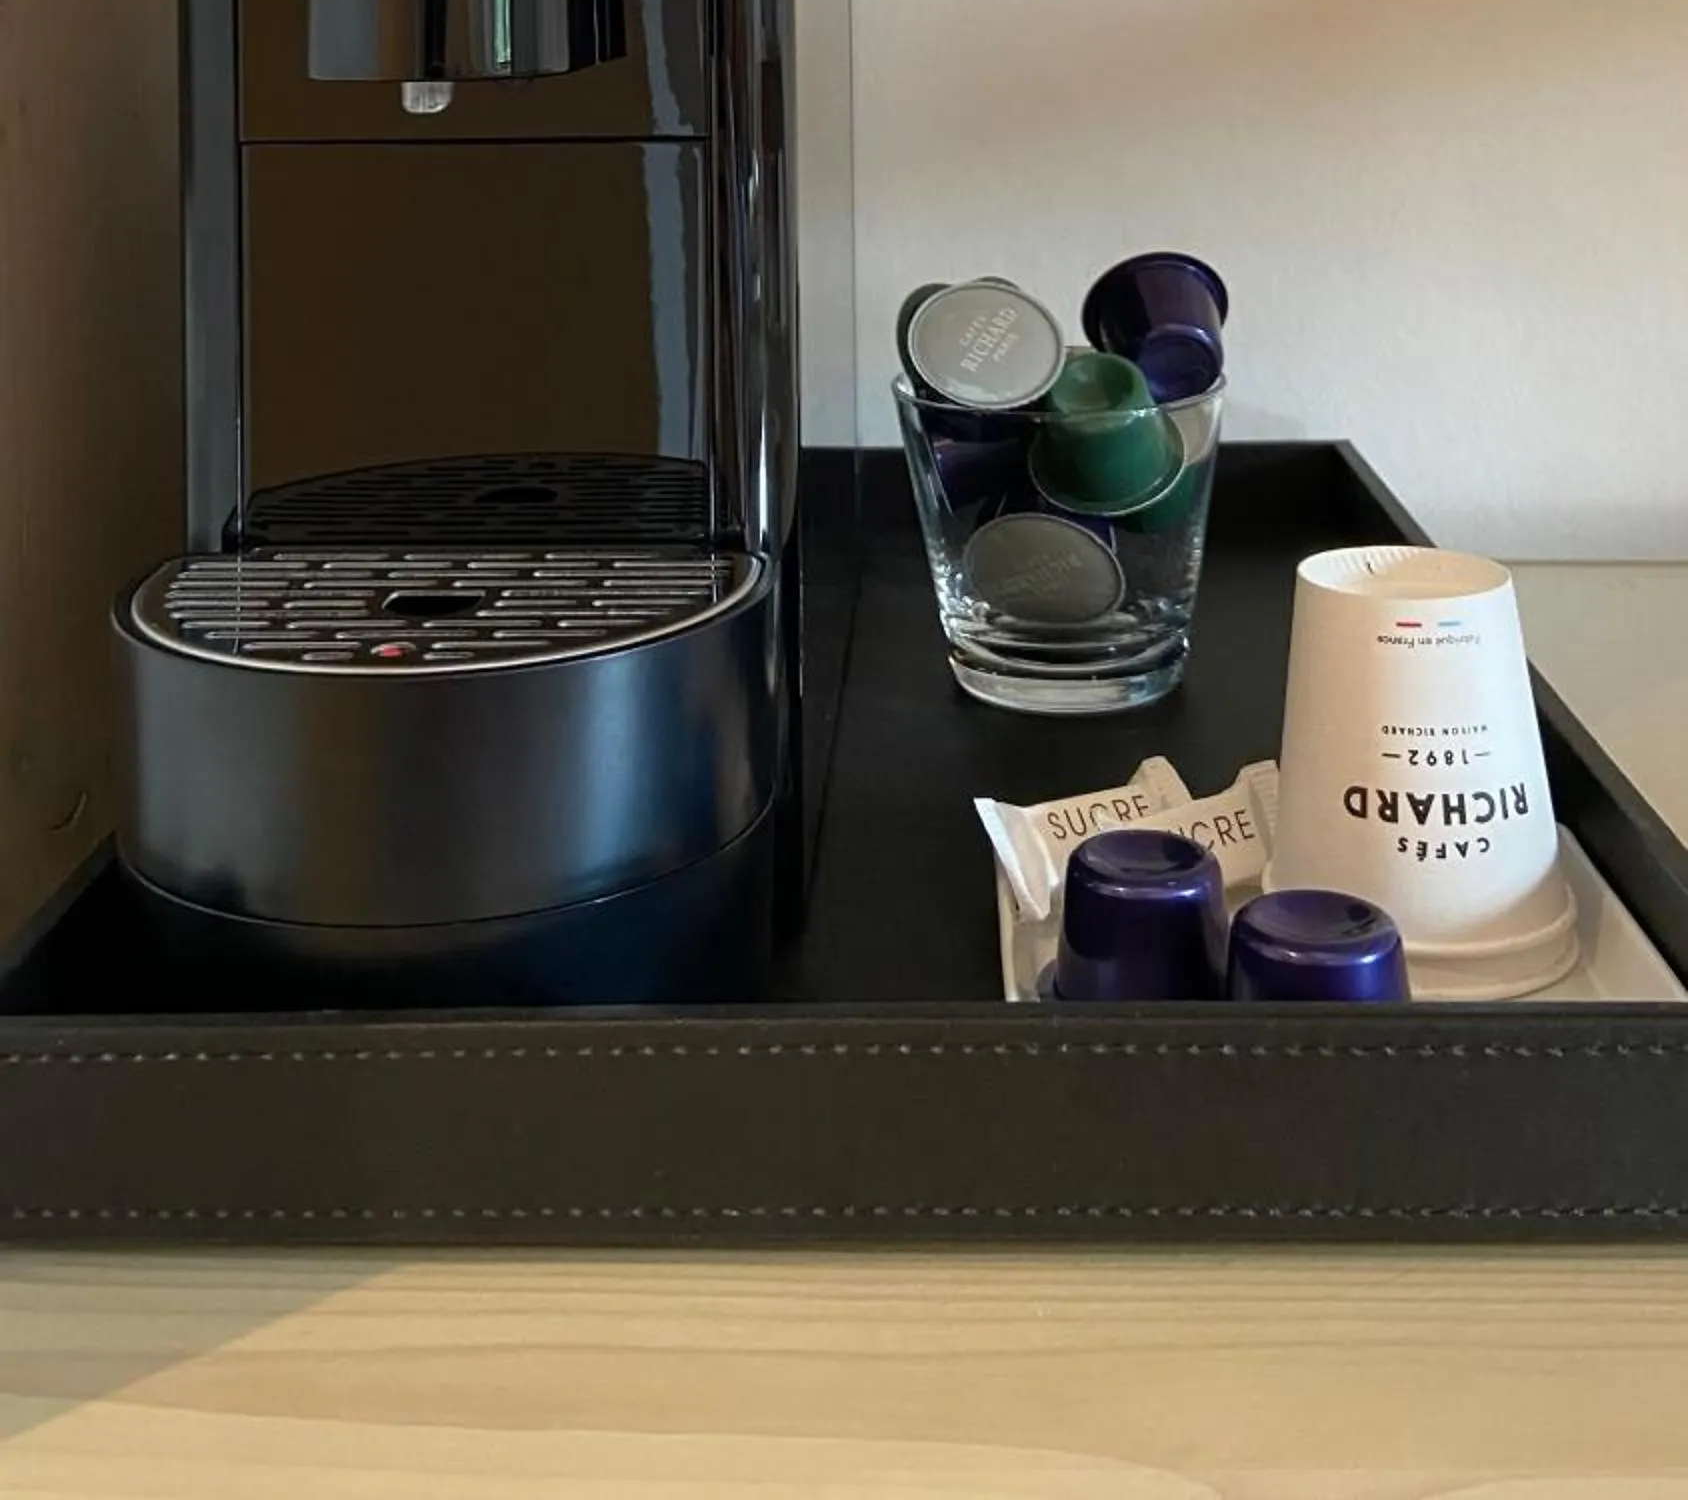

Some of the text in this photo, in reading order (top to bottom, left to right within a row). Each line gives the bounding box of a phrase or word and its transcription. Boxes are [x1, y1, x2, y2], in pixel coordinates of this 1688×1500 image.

[1381, 725, 1435, 737] RICHARD
[1343, 782, 1529, 826] RICHARD
[1397, 837, 1490, 861] CAFÉS
